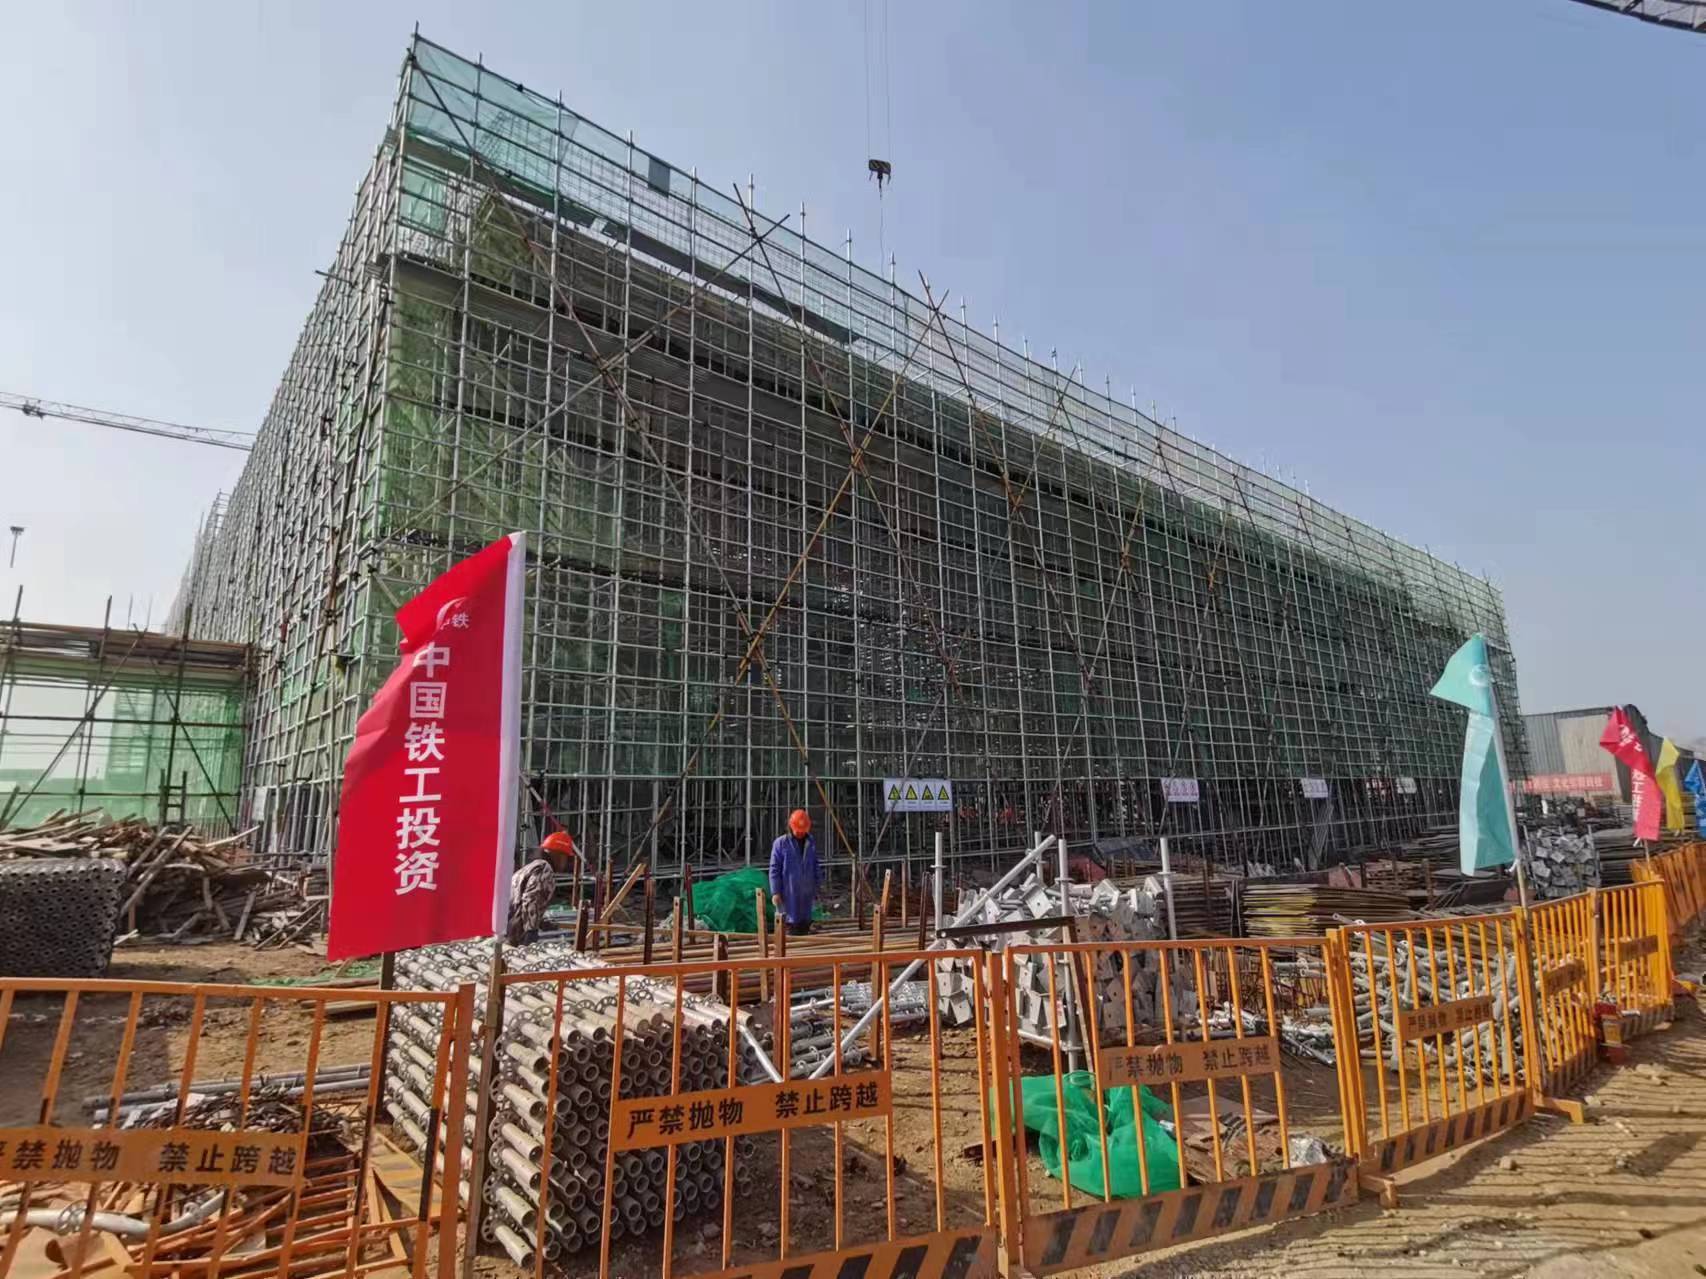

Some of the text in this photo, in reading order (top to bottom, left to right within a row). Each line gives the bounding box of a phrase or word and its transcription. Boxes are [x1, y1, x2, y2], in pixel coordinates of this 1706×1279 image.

[393, 641, 450, 895] 中国铁工投资
[627, 1081, 879, 1139] 严禁抛物 禁止跨越
[0, 1139, 297, 1176] 禁抛物 禁止跨越
